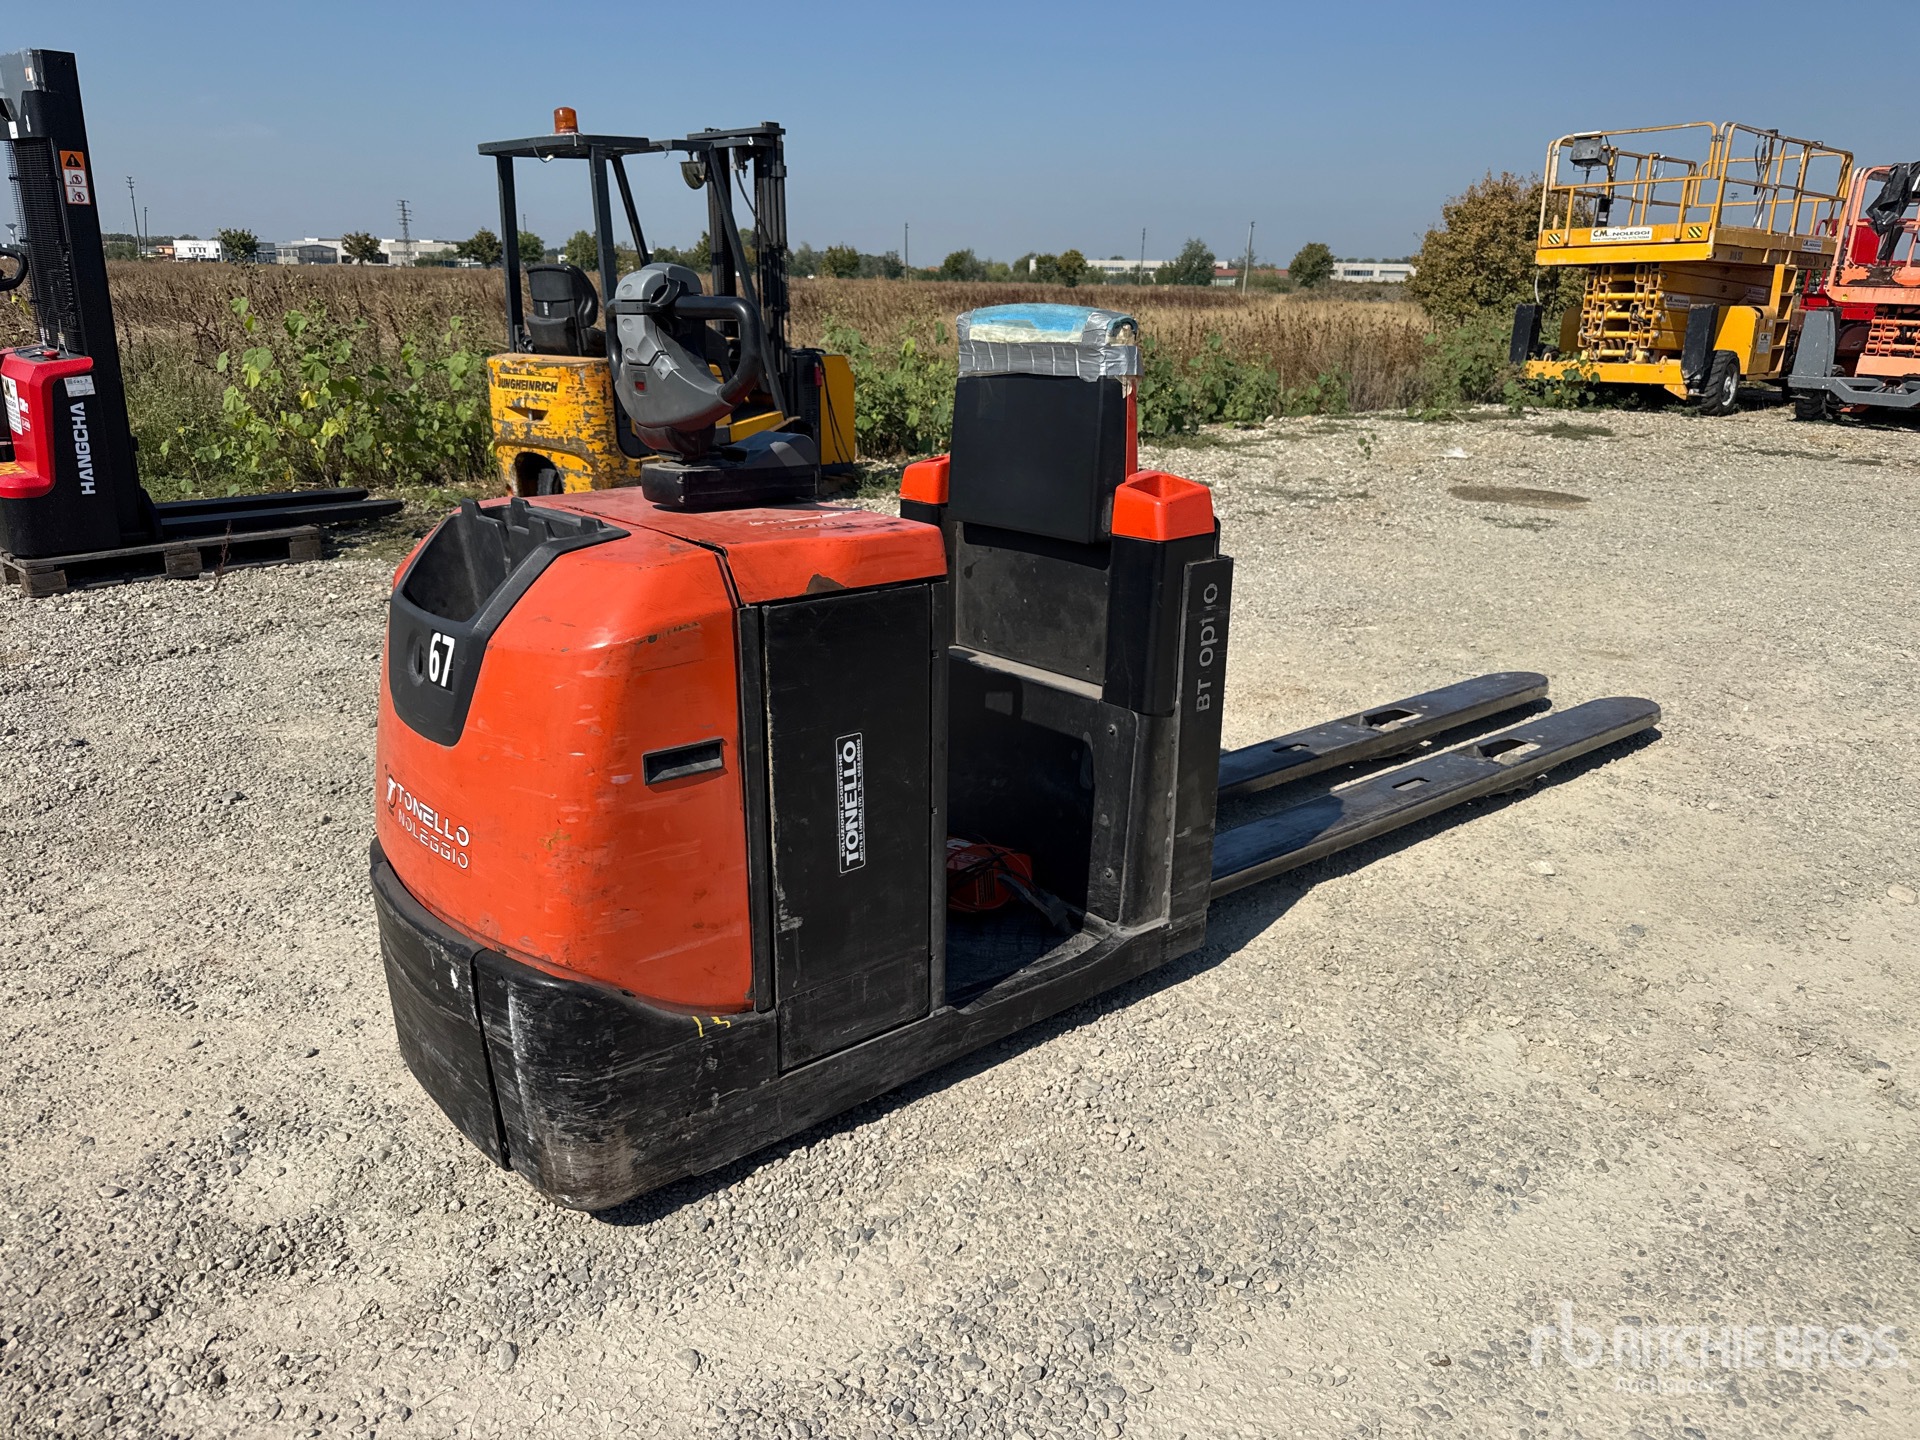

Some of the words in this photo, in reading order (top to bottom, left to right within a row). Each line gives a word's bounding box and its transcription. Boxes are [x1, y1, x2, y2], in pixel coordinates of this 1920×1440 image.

[70, 401, 96, 495] HANGCHA
[428, 632, 456, 688] 67
[1196, 679, 1212, 712] BT
[397, 783, 470, 847] TONELLO
[843, 740, 860, 866] TONELLO
[398, 808, 469, 869] NOLEGGIO
